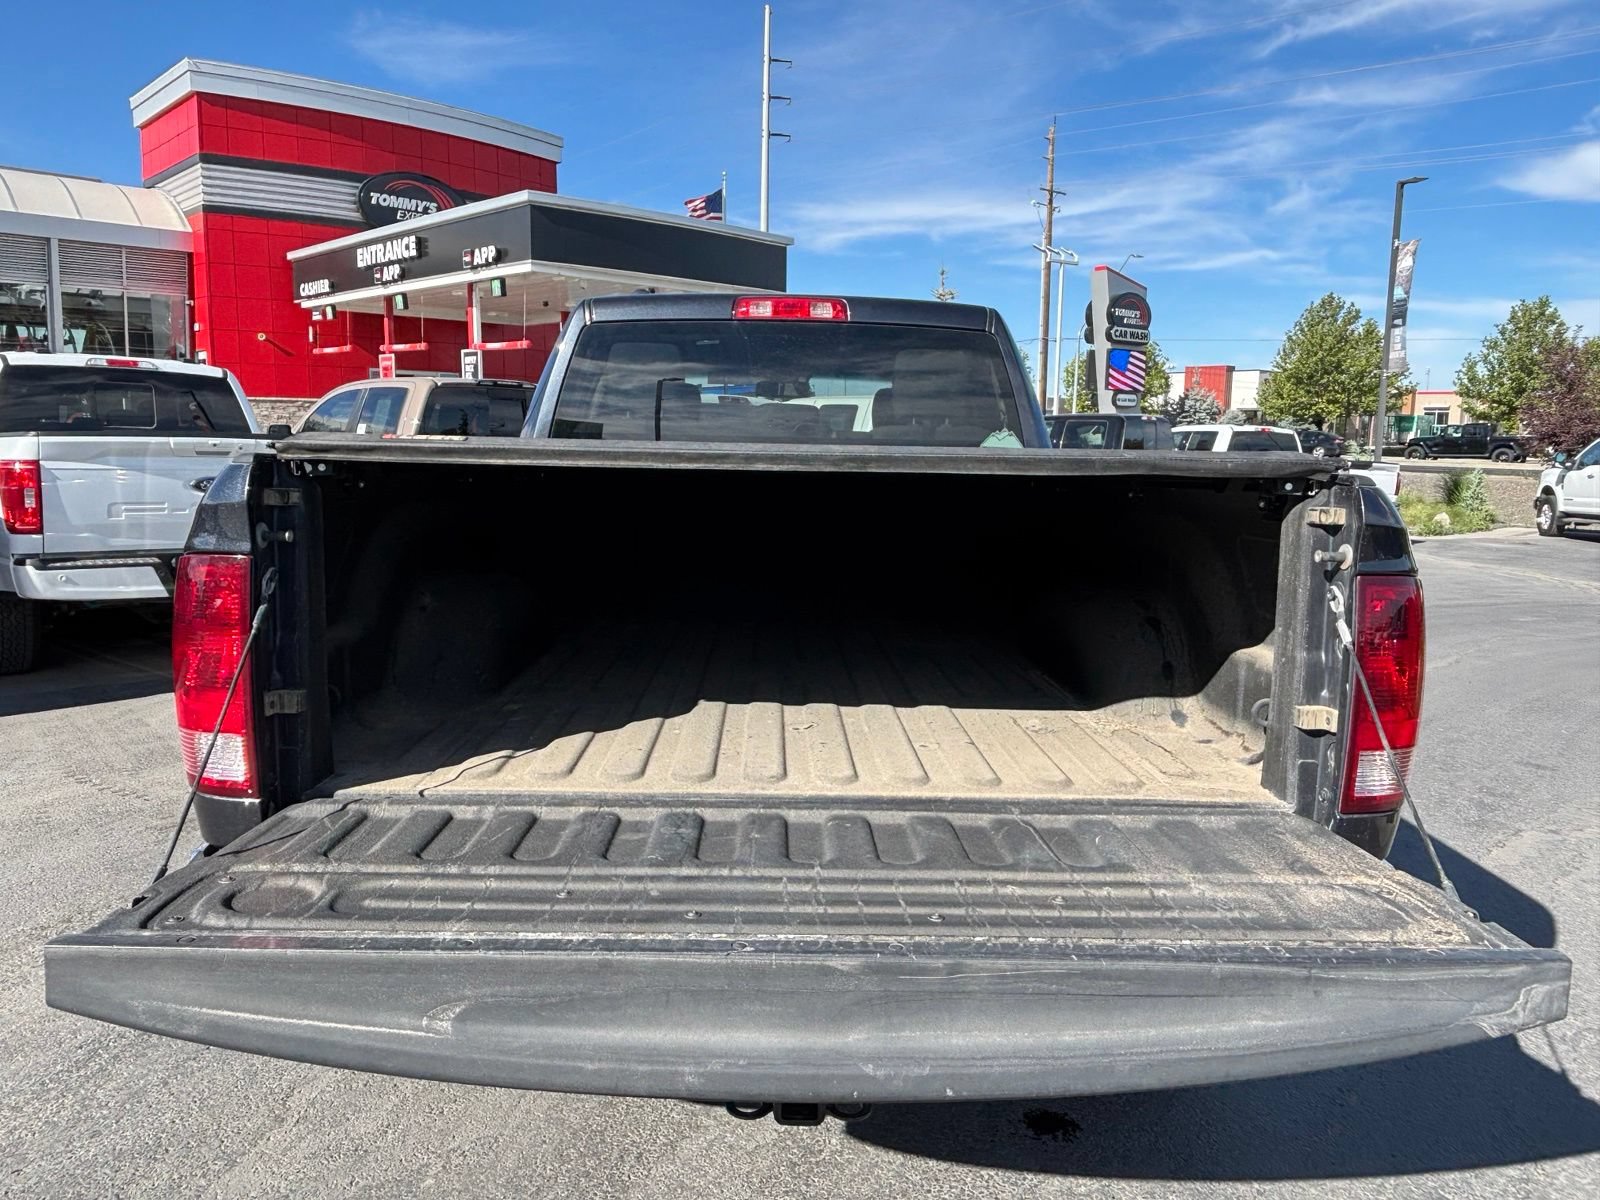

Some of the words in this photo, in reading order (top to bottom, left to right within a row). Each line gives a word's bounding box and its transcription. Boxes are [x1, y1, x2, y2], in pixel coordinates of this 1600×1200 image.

[370, 192, 438, 213] TOMMY'S
[356, 235, 417, 268] ENTRANCE
[473, 245, 496, 265] APP
[382, 264, 400, 281] APP
[300, 279, 330, 296] CASHIER
[1114, 329, 1128, 339] CAR
[1130, 330, 1149, 341] WASH
